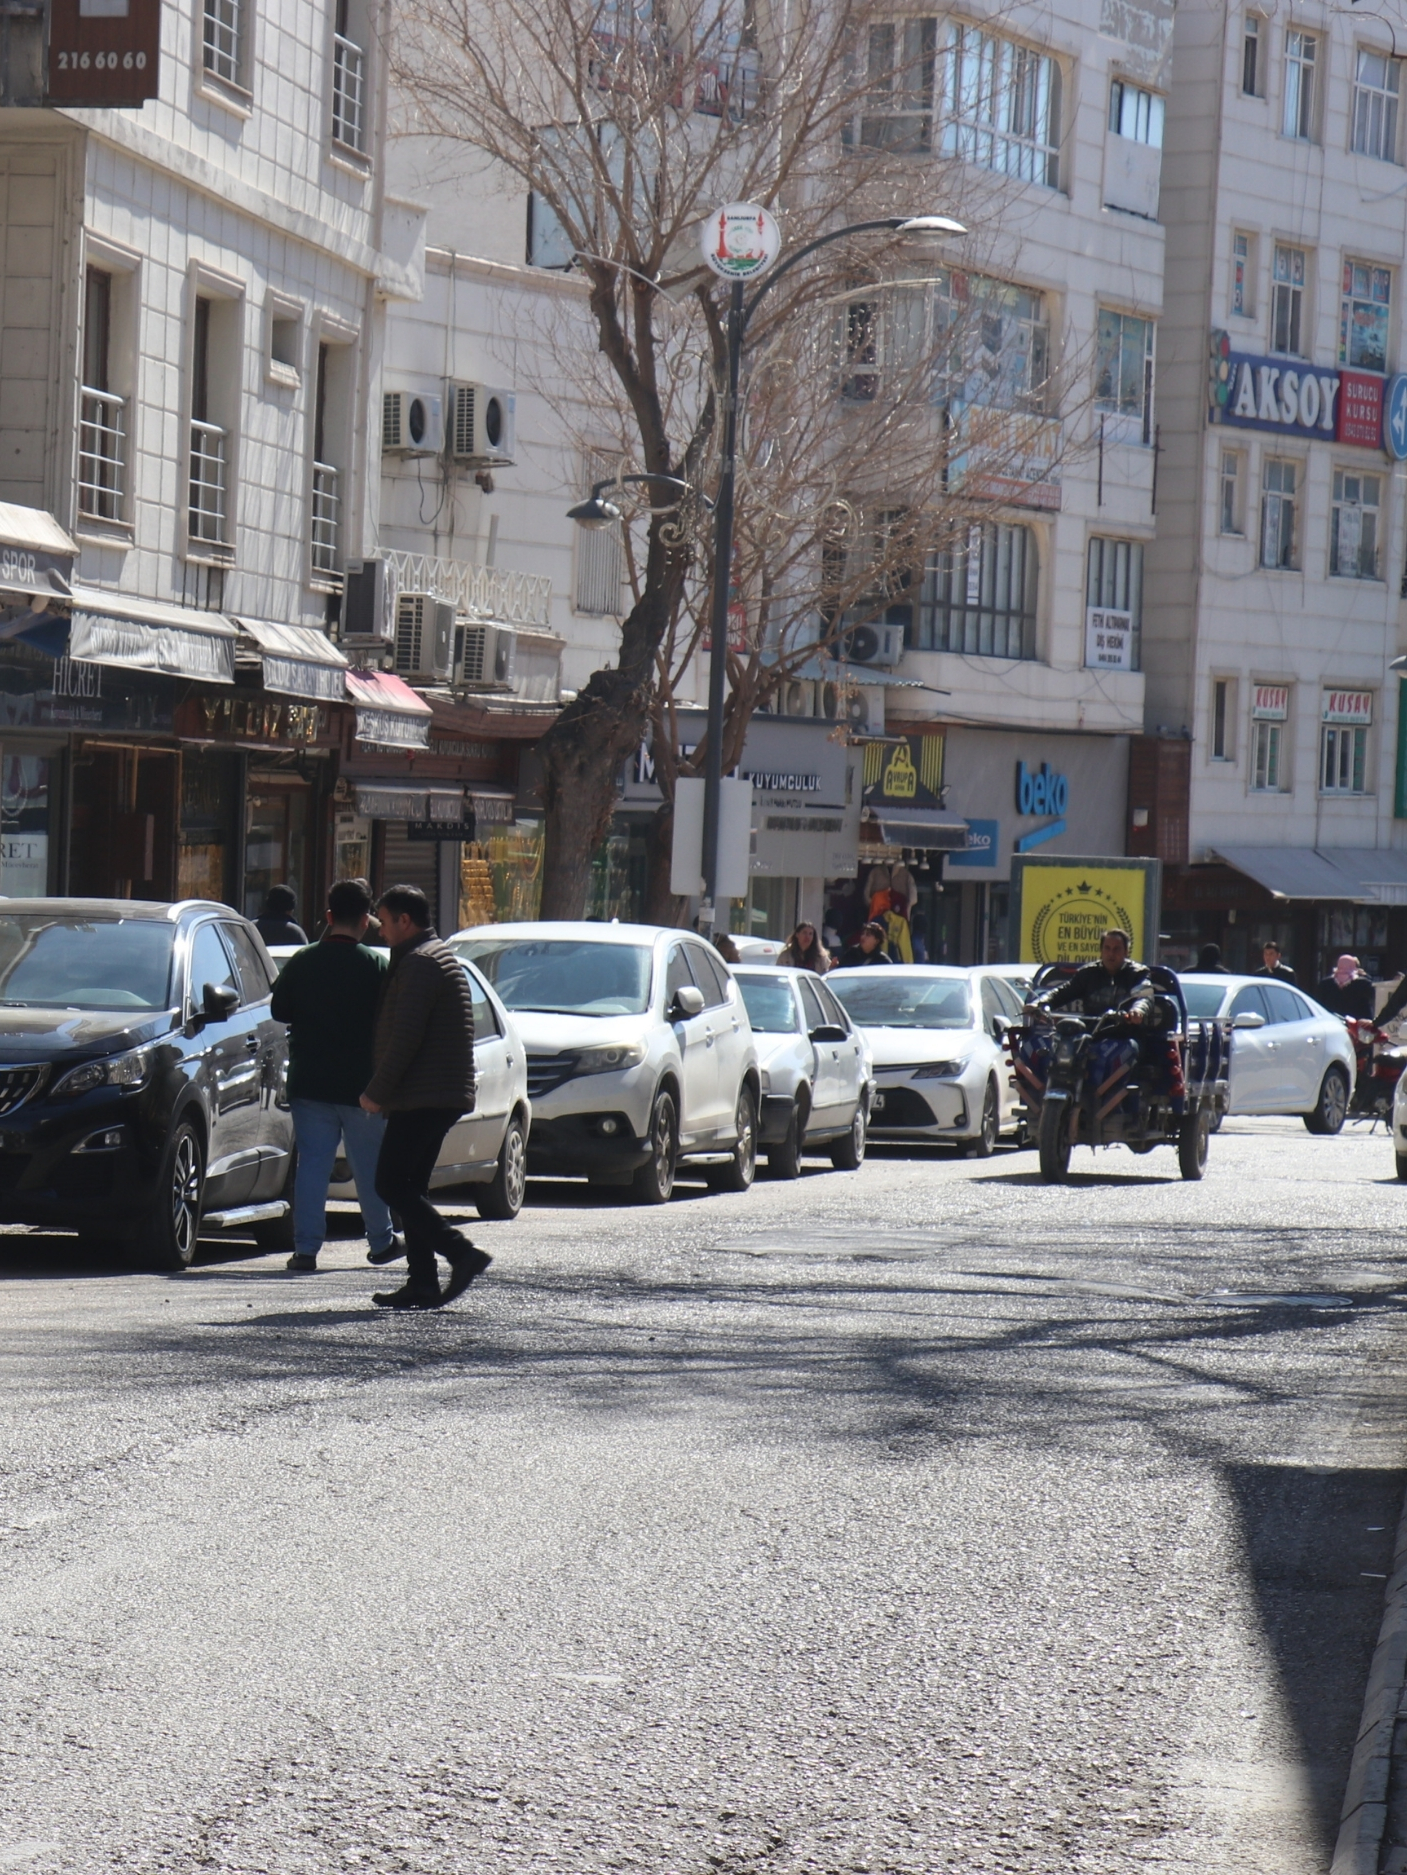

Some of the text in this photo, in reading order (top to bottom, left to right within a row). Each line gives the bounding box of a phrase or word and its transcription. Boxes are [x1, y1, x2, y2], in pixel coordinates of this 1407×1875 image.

[58, 51, 146, 70] 216 60 60
[1232, 361, 1340, 431] AKSOY
[1, 550, 36, 584] SPOR
[748, 772, 822, 791] KUYUMCULUK
[1016, 760, 1069, 815] beko
[1058, 926, 1071, 939] EN
[1057, 942, 1067, 952] VE
[1069, 942, 1078, 952] EN
